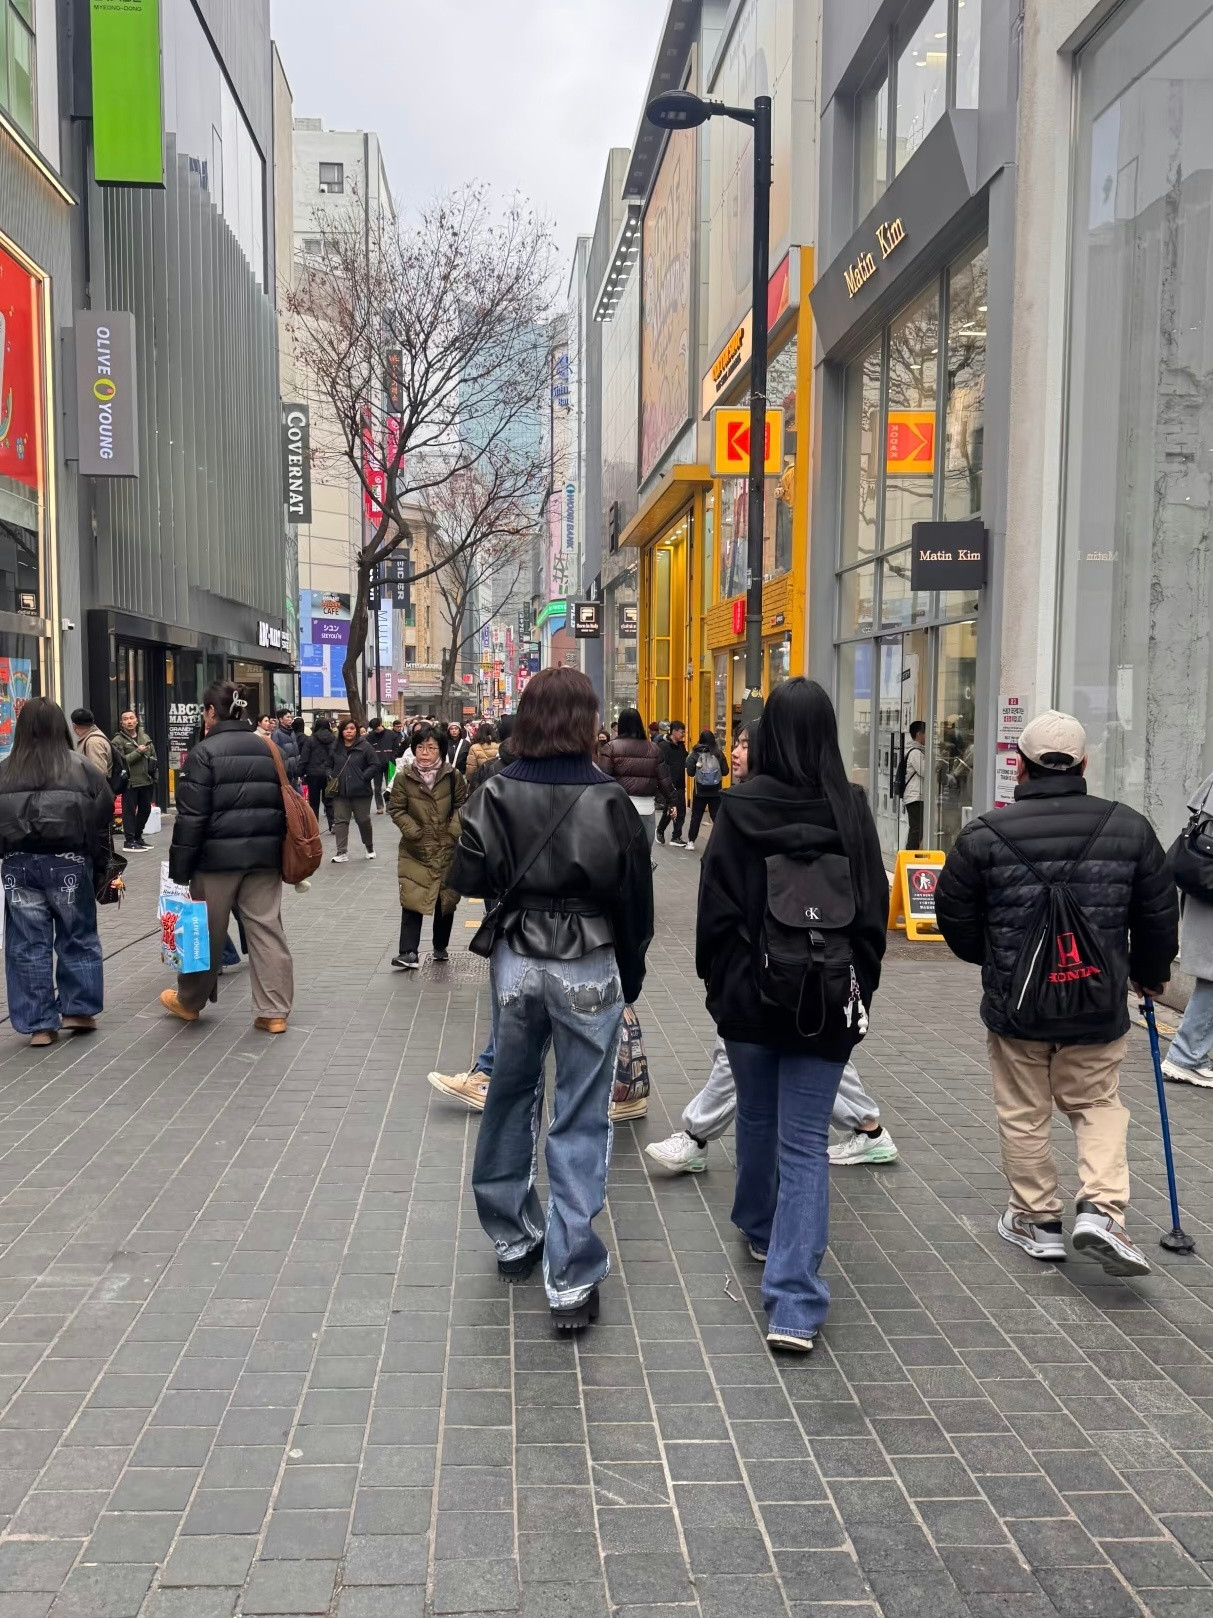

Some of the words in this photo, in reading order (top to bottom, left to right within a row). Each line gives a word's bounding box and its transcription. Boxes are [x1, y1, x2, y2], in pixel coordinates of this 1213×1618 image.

[93, 4, 142, 12] MYEONG-DONG
[843, 252, 877, 299] Matin
[875, 218, 906, 260] Kim
[96, 326, 111, 376] OLIVE
[98, 402, 113, 460] YOUNG
[287, 411, 306, 515] COVERNAT
[919, 550, 953, 561] Matin
[957, 549, 981, 561] Kim
[169, 703, 194, 715] ABC
[169, 715, 194, 723] MART
